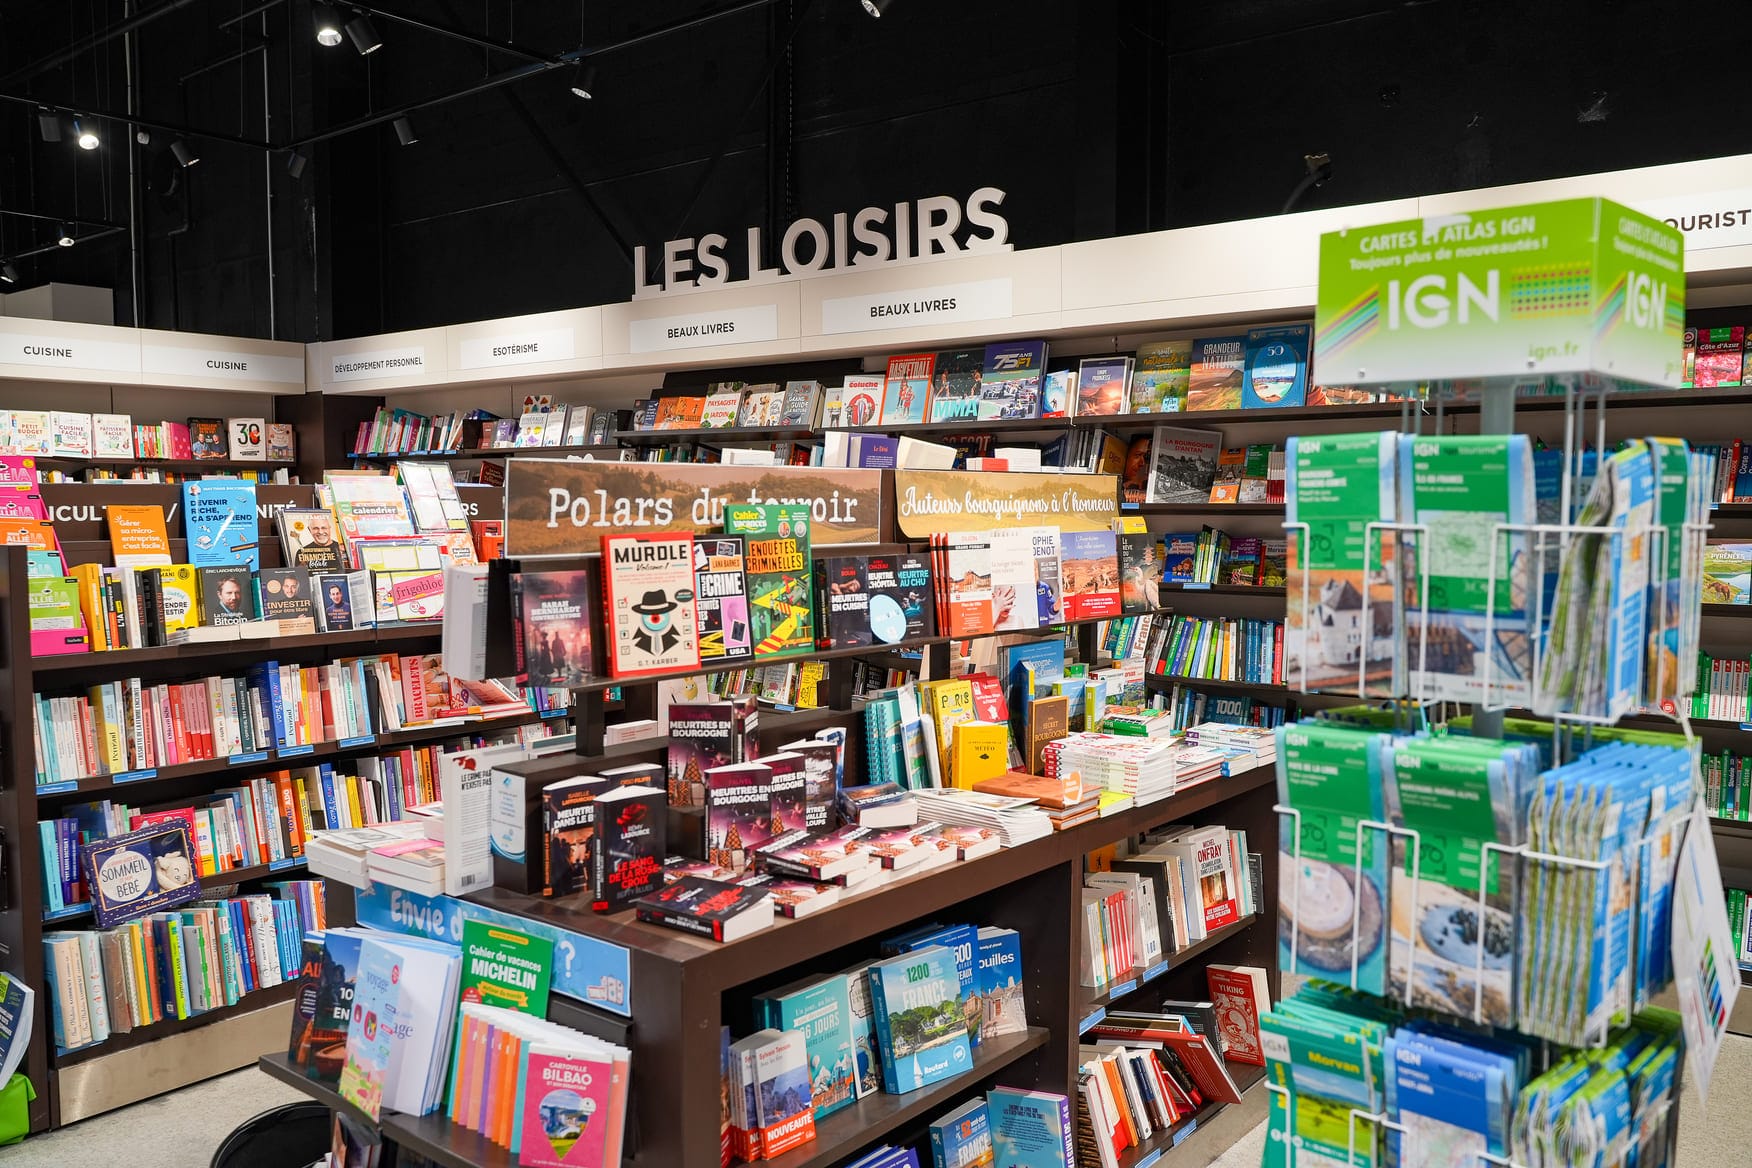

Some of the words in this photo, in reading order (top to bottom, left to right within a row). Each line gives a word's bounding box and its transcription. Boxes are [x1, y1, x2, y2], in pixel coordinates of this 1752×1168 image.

[633, 233, 730, 296] LES
[747, 187, 1009, 278] LOISIRS
[1360, 230, 1417, 253] CARTES
[1443, 219, 1496, 243] ATLAS
[1501, 216, 1536, 235] IGN
[1350, 256, 1401, 271] Toujours
[1404, 251, 1432, 267] plus
[1435, 248, 1451, 261] de
[1456, 240, 1540, 259] nouveautés
[1388, 269, 1500, 329] IGN
[1625, 270, 1667, 332] IGN
[870, 303, 911, 318] BEAUX
[914, 298, 957, 314] LIVRES
[667, 325, 699, 339] BEAUX
[701, 322, 735, 335] LIVRES
[23, 345, 73, 358] CUISINE
[492, 343, 539, 357] ESOTÉRISME
[1203, 342, 1241, 354] GRANDEUR
[1267, 346, 1284, 356] 50
[1528, 341, 1580, 360] ign.fr
[1700, 342, 1716, 350] Côte
[1717, 342, 1739, 350] d'Azur
[206, 359, 248, 371] CUISINE
[334, 359, 385, 373] DÉVELOPPEMENT
[386, 356, 423, 368] PERSONNEL
[889, 359, 931, 378] BASKETBALL
[993, 354, 1019, 370] 75
[1016, 357, 1032, 369] F1
[708, 399, 737, 407] PAYSAGISTE
[934, 400, 979, 418] MMA
[236, 423, 260, 445] 30
[1175, 440, 1215, 449] BOURGOGNE
[1298, 440, 1321, 453] IGN
[1414, 442, 1439, 456] IGN
[353, 506, 397, 515] calendrier
[547, 488, 673, 528] Polars
[691, 488, 725, 526] du
[901, 486, 960, 516] Auteurs
[965, 490, 1049, 520] bourguignons
[1051, 494, 1060, 513] à
[1062, 488, 1115, 513] l'honneur
[49, 505, 107, 522] ICUL
[119, 519, 141, 527] Gérer
[130, 527, 155, 535] micro-
[122, 535, 163, 544] entreprise,
[614, 544, 688, 563] MURDLE
[746, 555, 802, 571] CRIMINELLES
[396, 580, 444, 598] frigobloc
[706, 572, 743, 597] CRIME
[911, 578, 926, 586] CHU
[267, 600, 311, 609] INVESTIR
[541, 600, 569, 609] SARAH
[832, 593, 868, 604] MEURTRES
[531, 606, 581, 616] BERNHARDT
[832, 604, 843, 612] EN
[843, 602, 868, 611] CUISINE
[214, 616, 248, 626] Bitcoin
[1114, 622, 1129, 658] FRANCE
[729, 647, 746, 655] USA
[409, 658, 425, 719] BRACELETS
[1216, 699, 1241, 714] 1000
[670, 721, 718, 730] MEURTRES
[718, 721, 731, 729] EN
[672, 729, 729, 738] BOURGOGNE
[1286, 733, 1308, 746] IGN
[1396, 755, 1421, 769] IGN
[711, 786, 758, 798] MEURTRES
[758, 785, 771, 794] EN
[713, 793, 769, 806] BOURGOGNE
[554, 815, 575, 829] DANS
[576, 814, 587, 826] LE
[1202, 839, 1216, 849] MICHEL
[1197, 844, 1223, 863] ONFRAY
[629, 856, 654, 869] SANG
[101, 858, 147, 883] SOMMEIL
[609, 873, 621, 884] DE
[622, 871, 634, 880] LA
[634, 864, 662, 878] ROSE-
[116, 879, 140, 898] BÉBÉ
[621, 877, 649, 889] CROIX
[391, 890, 445, 936] Envie
[559, 940, 576, 978] ?
[469, 944, 496, 959] Cahier
[496, 951, 507, 962] de
[508, 955, 542, 972] vacances
[471, 958, 537, 991] MICHELIN
[906, 963, 929, 984] 1200
[902, 979, 948, 1009] FRANCE
[333, 1007, 350, 1020] EN
[814, 1012, 840, 1036] JOURS
[1308, 1051, 1361, 1074] Morvan
[1396, 1048, 1421, 1066] IGN
[549, 1062, 587, 1073] CARTOVILLE
[924, 1060, 949, 1075] Routard
[542, 1068, 592, 1086] BILBAO
[767, 1112, 813, 1142] NOUVEAUTÉ
[958, 1132, 991, 1167] FRANCE
